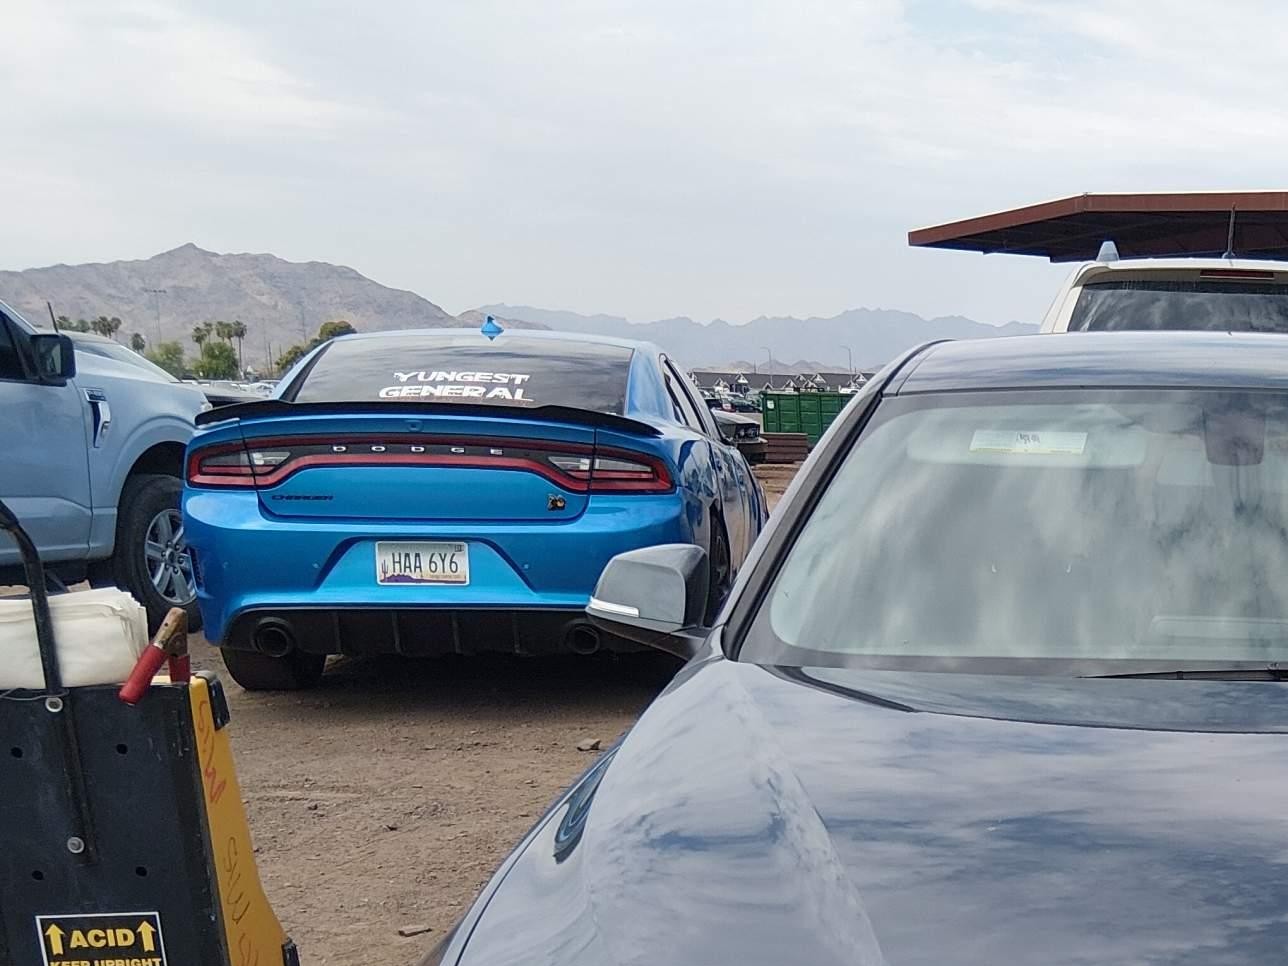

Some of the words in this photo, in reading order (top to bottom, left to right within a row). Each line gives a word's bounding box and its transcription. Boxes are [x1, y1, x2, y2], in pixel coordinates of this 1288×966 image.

[393, 371, 530, 385] YUNGEST
[379, 385, 534, 402] GENERAL
[333, 446, 502, 455] DODGE
[392, 552, 422, 573] HAA
[429, 553, 459, 573] 6Y6
[70, 928, 135, 949] ACID
